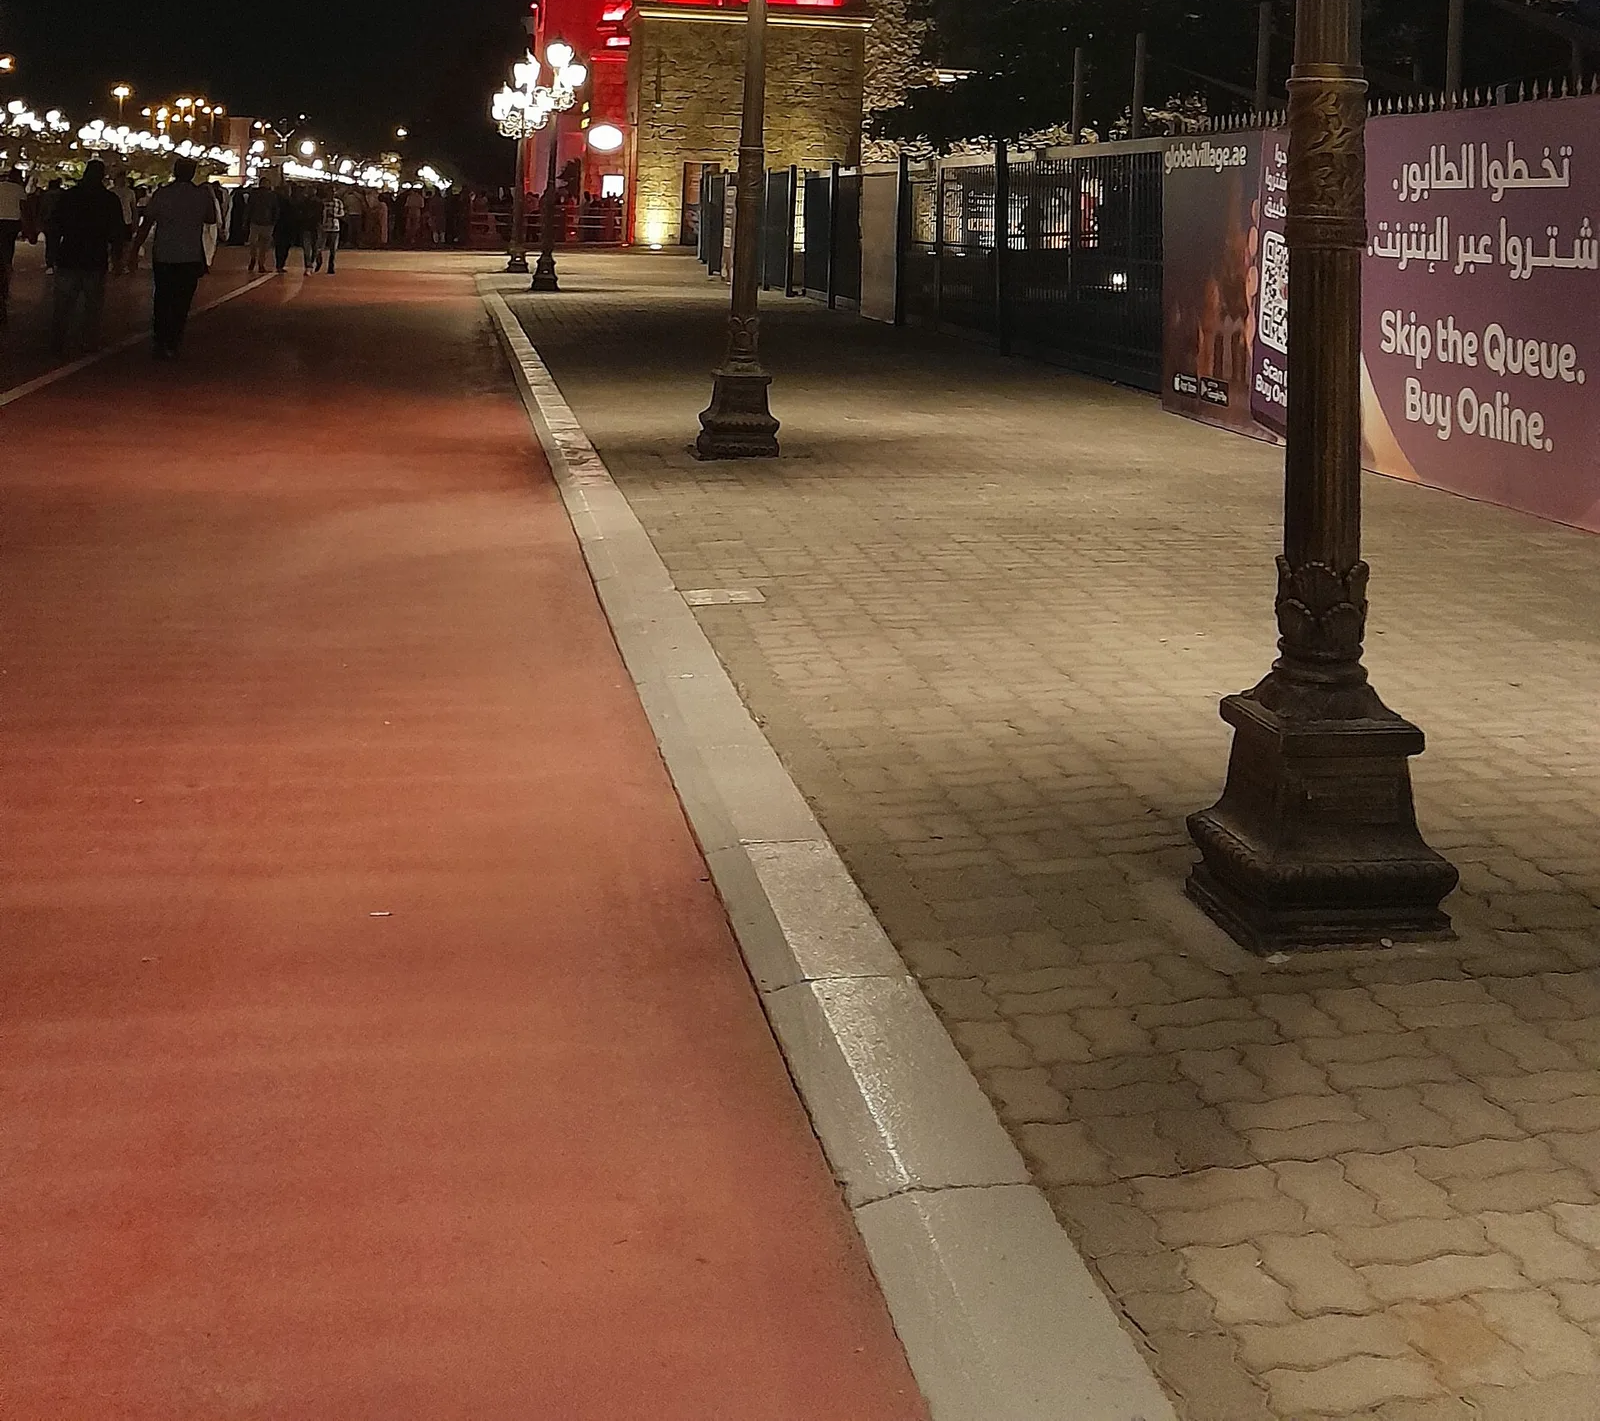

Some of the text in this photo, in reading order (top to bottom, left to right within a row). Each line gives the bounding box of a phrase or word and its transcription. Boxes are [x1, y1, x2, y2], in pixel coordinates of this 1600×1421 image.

[1164, 141, 1247, 175] globalvillage.ae
[1392, 141, 1573, 202] تخطوا الطابور.
[1453, 235, 1493, 274] عبر
[1500, 217, 1599, 280] شتروا
[1262, 358, 1283, 385] Scan
[1380, 309, 1586, 385] Skip the Queue.
[1255, 373, 1272, 402] Buy
[1405, 377, 1554, 452] Buy Online.
